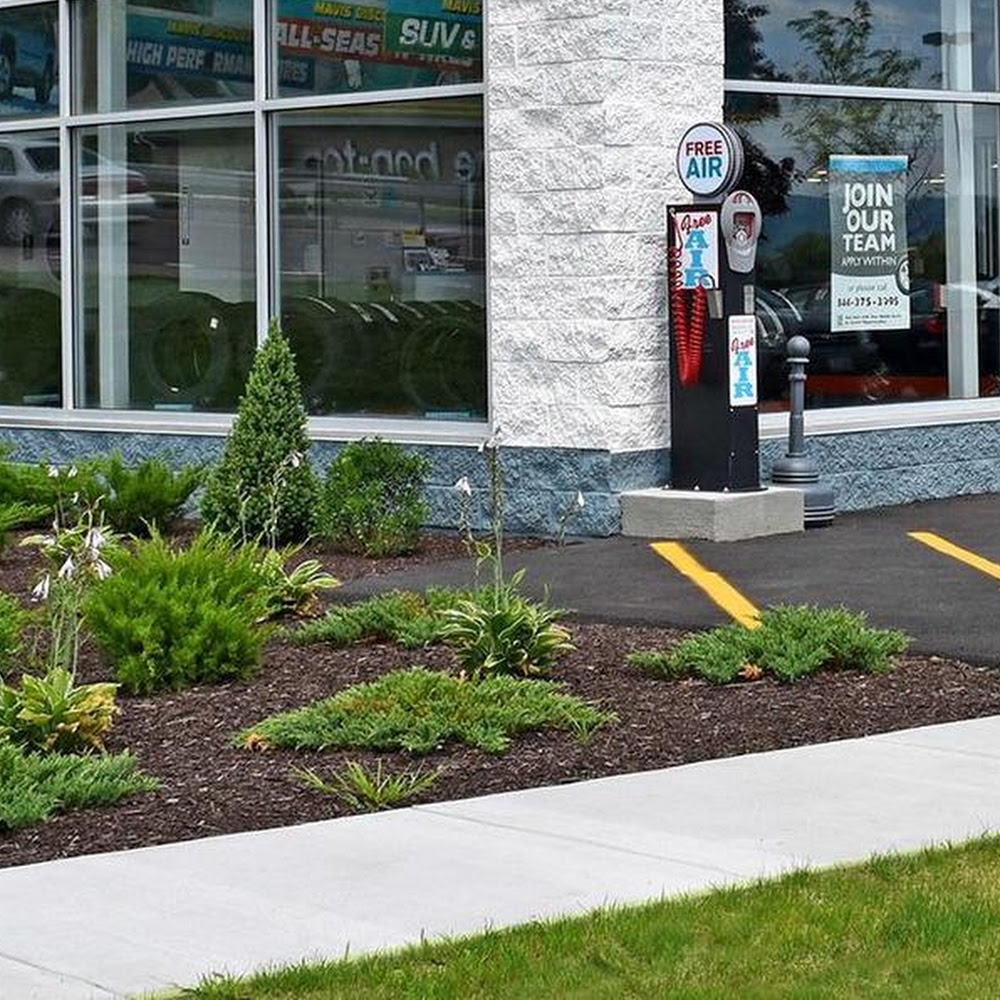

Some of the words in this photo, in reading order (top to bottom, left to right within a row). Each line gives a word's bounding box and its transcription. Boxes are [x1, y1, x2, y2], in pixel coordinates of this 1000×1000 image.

[400, 18, 460, 48] SUV
[127, 40, 163, 66] HIGH
[686, 140, 722, 156] FREE
[686, 157, 722, 179] AIR
[842, 182, 894, 213] JOIN
[846, 210, 895, 233] OUR
[842, 233, 896, 252] TEAM
